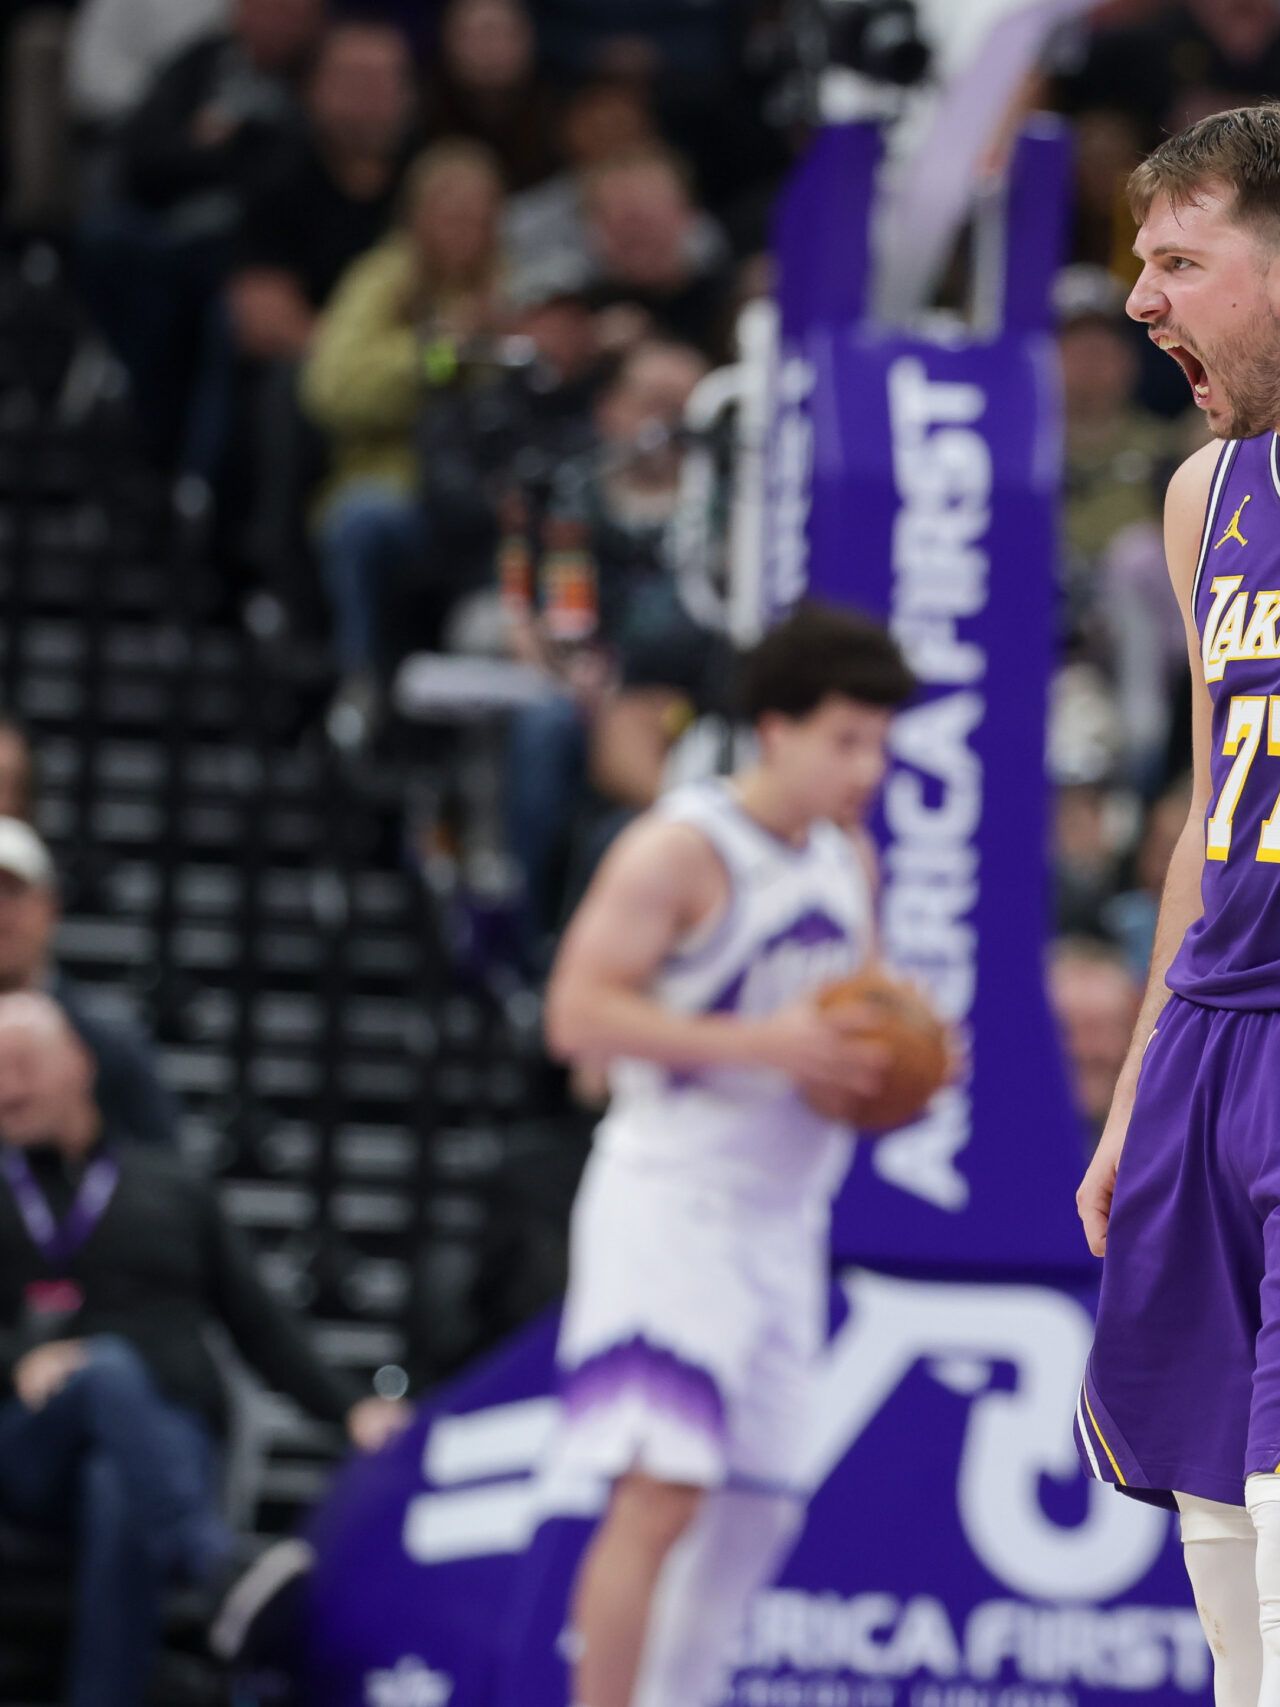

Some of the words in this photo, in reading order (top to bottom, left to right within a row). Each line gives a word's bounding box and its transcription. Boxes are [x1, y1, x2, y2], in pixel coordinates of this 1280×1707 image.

[887, 355, 994, 685] FIRST
[872, 690, 984, 1213] AERICA
[964, 1597, 1213, 1693] FIRST
